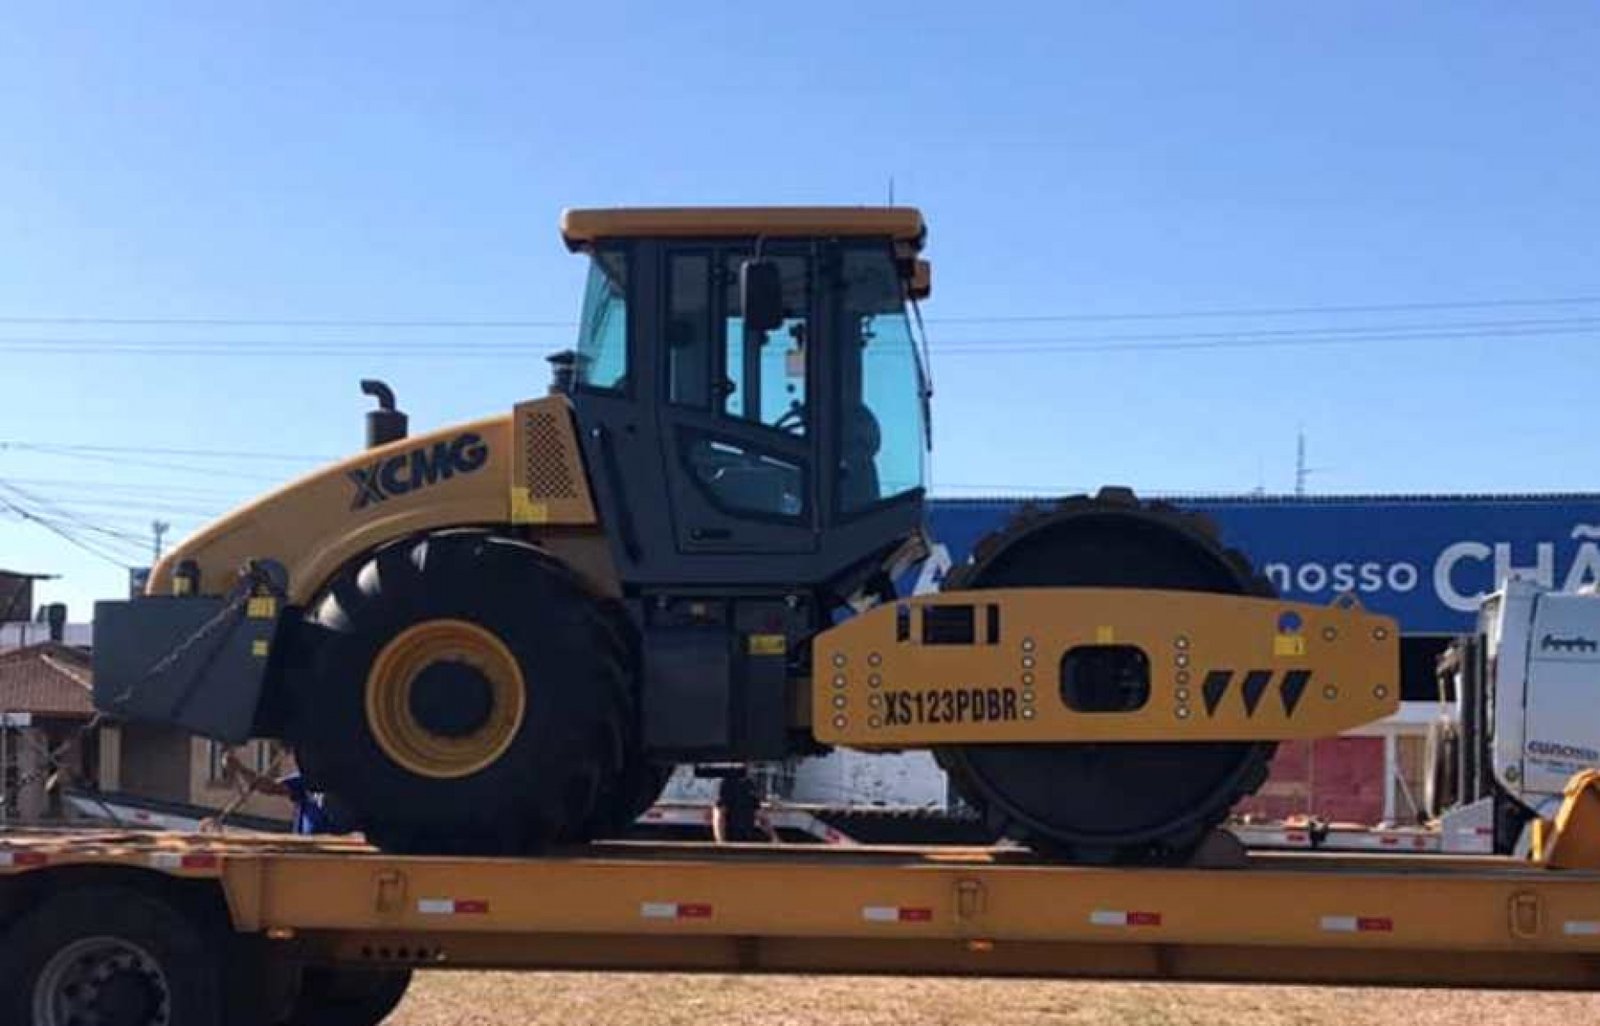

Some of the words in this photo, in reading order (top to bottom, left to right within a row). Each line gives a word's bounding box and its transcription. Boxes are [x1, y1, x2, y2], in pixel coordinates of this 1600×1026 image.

[346, 432, 488, 512] XCMG
[1264, 562, 1418, 593] nosso
[883, 687, 1018, 726] XS123PDBR
